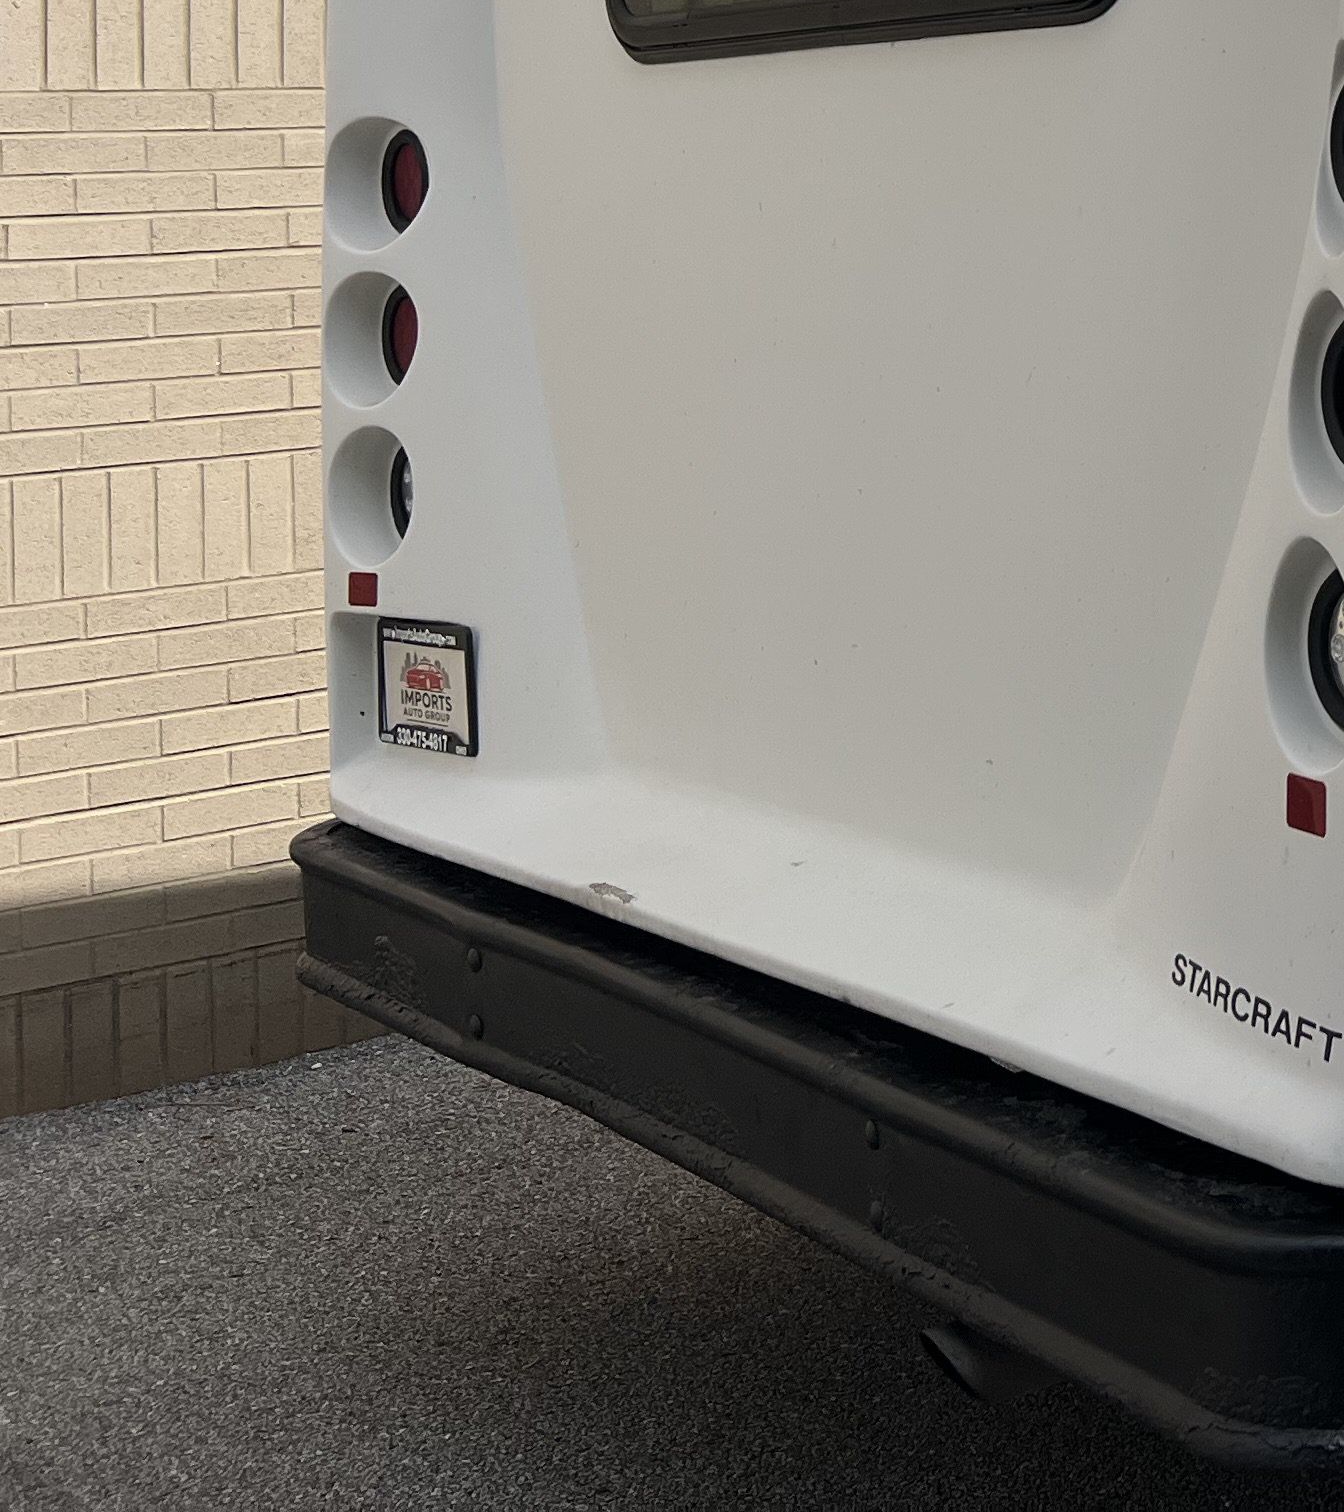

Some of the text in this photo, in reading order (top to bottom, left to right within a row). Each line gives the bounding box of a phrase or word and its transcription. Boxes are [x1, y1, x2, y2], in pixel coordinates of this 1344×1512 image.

[400, 688, 453, 712] IMPORTS
[403, 706, 450, 722] AUTO GROUP
[1171, 952, 1343, 1063] STARCRAFT
